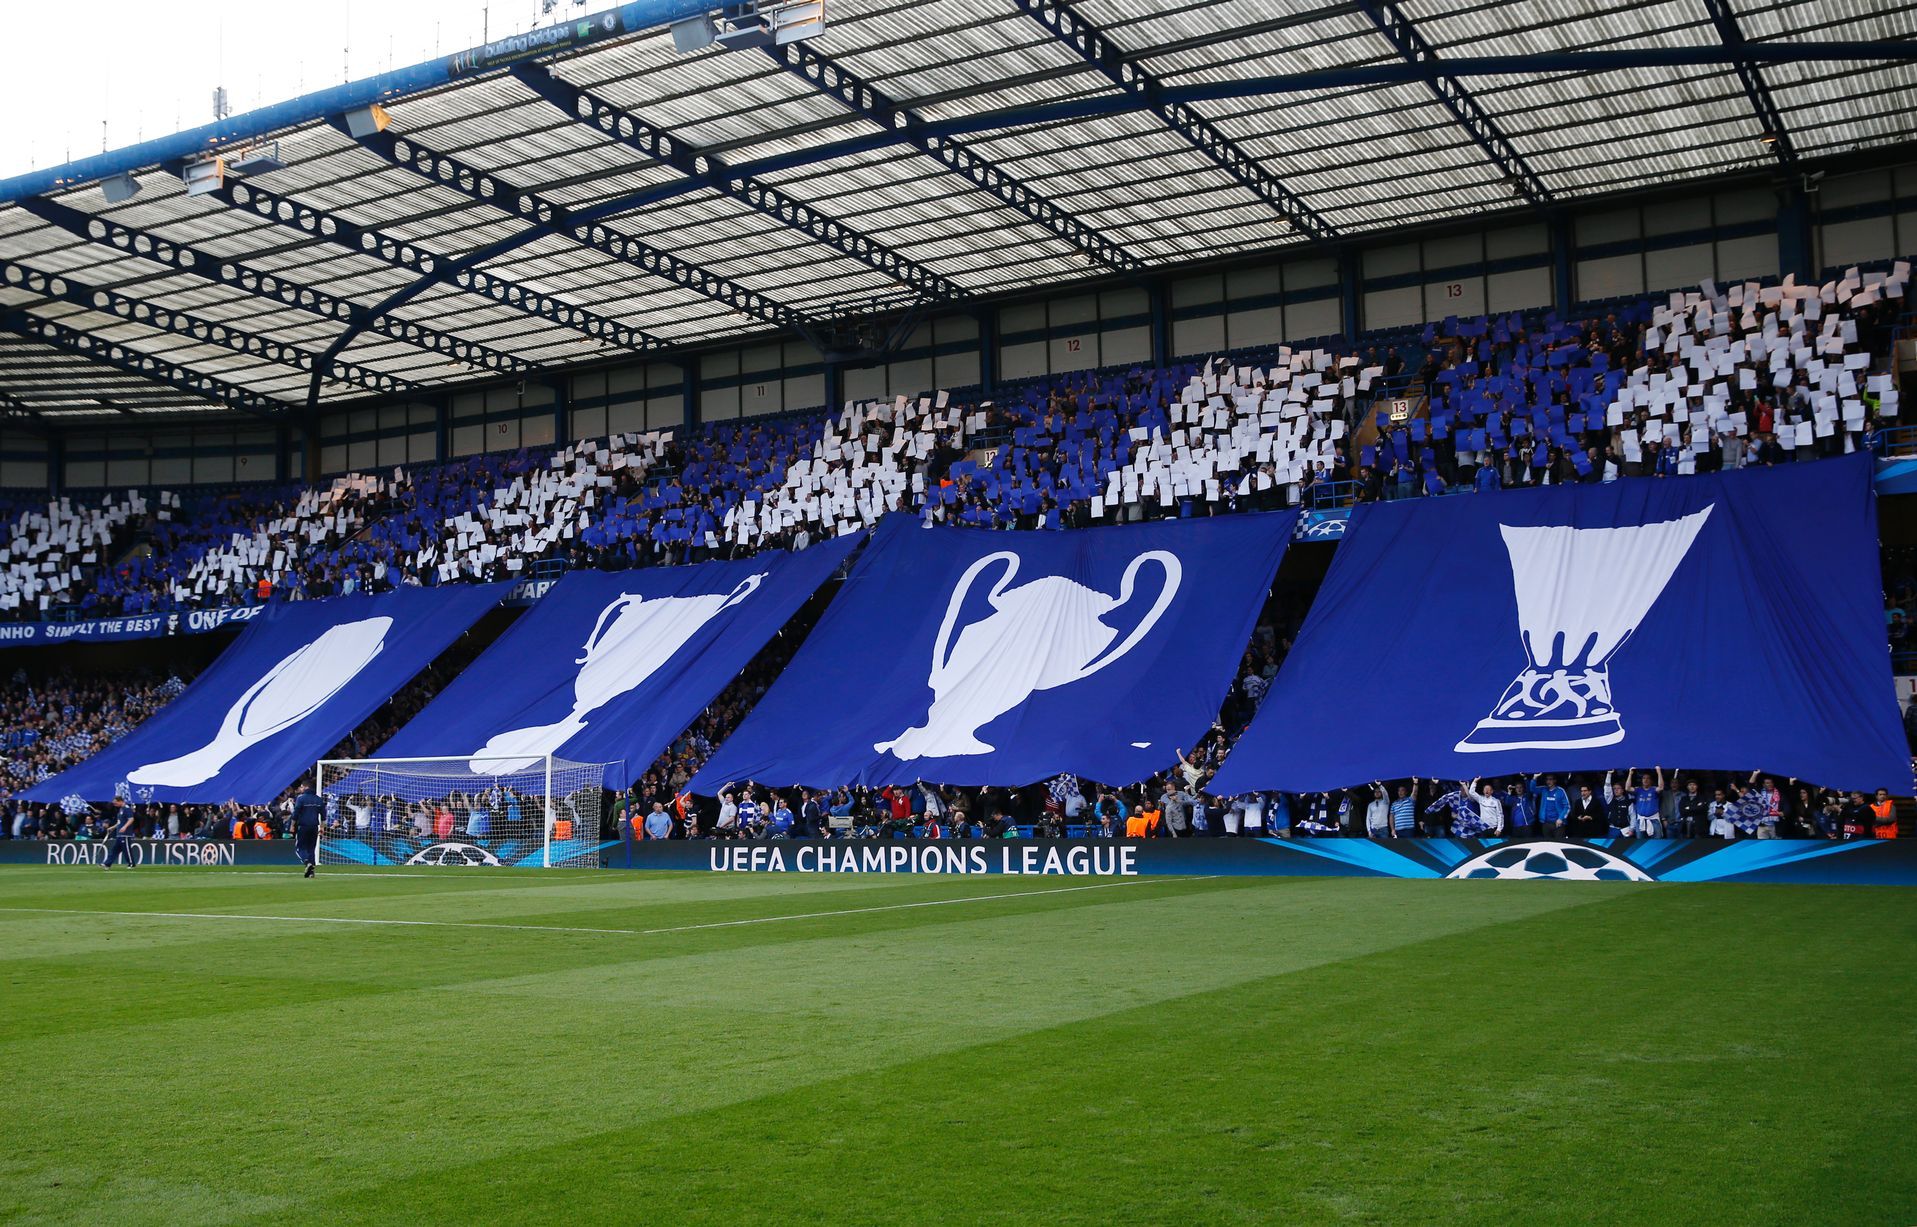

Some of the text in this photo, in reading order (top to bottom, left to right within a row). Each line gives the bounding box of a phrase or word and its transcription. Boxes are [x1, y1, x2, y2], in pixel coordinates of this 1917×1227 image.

[485, 36, 528, 58] building
[528, 26, 569, 46] bridges
[1447, 284, 1462, 297] 13
[1067, 339, 1080, 352] 12
[757, 385, 765, 396] 11
[1393, 402, 1407, 413] 13
[498, 423, 508, 434] 10
[230, 604, 265, 620] OF
[45, 621, 96, 638] SIMPLY
[99, 621, 122, 634] THE
[126, 617, 160, 633] BEST
[47, 843, 108, 865] ROAD
[150, 843, 235, 866] LISBON
[710, 845, 1138, 875] UEFA CHAMPIONS LEAGUE
